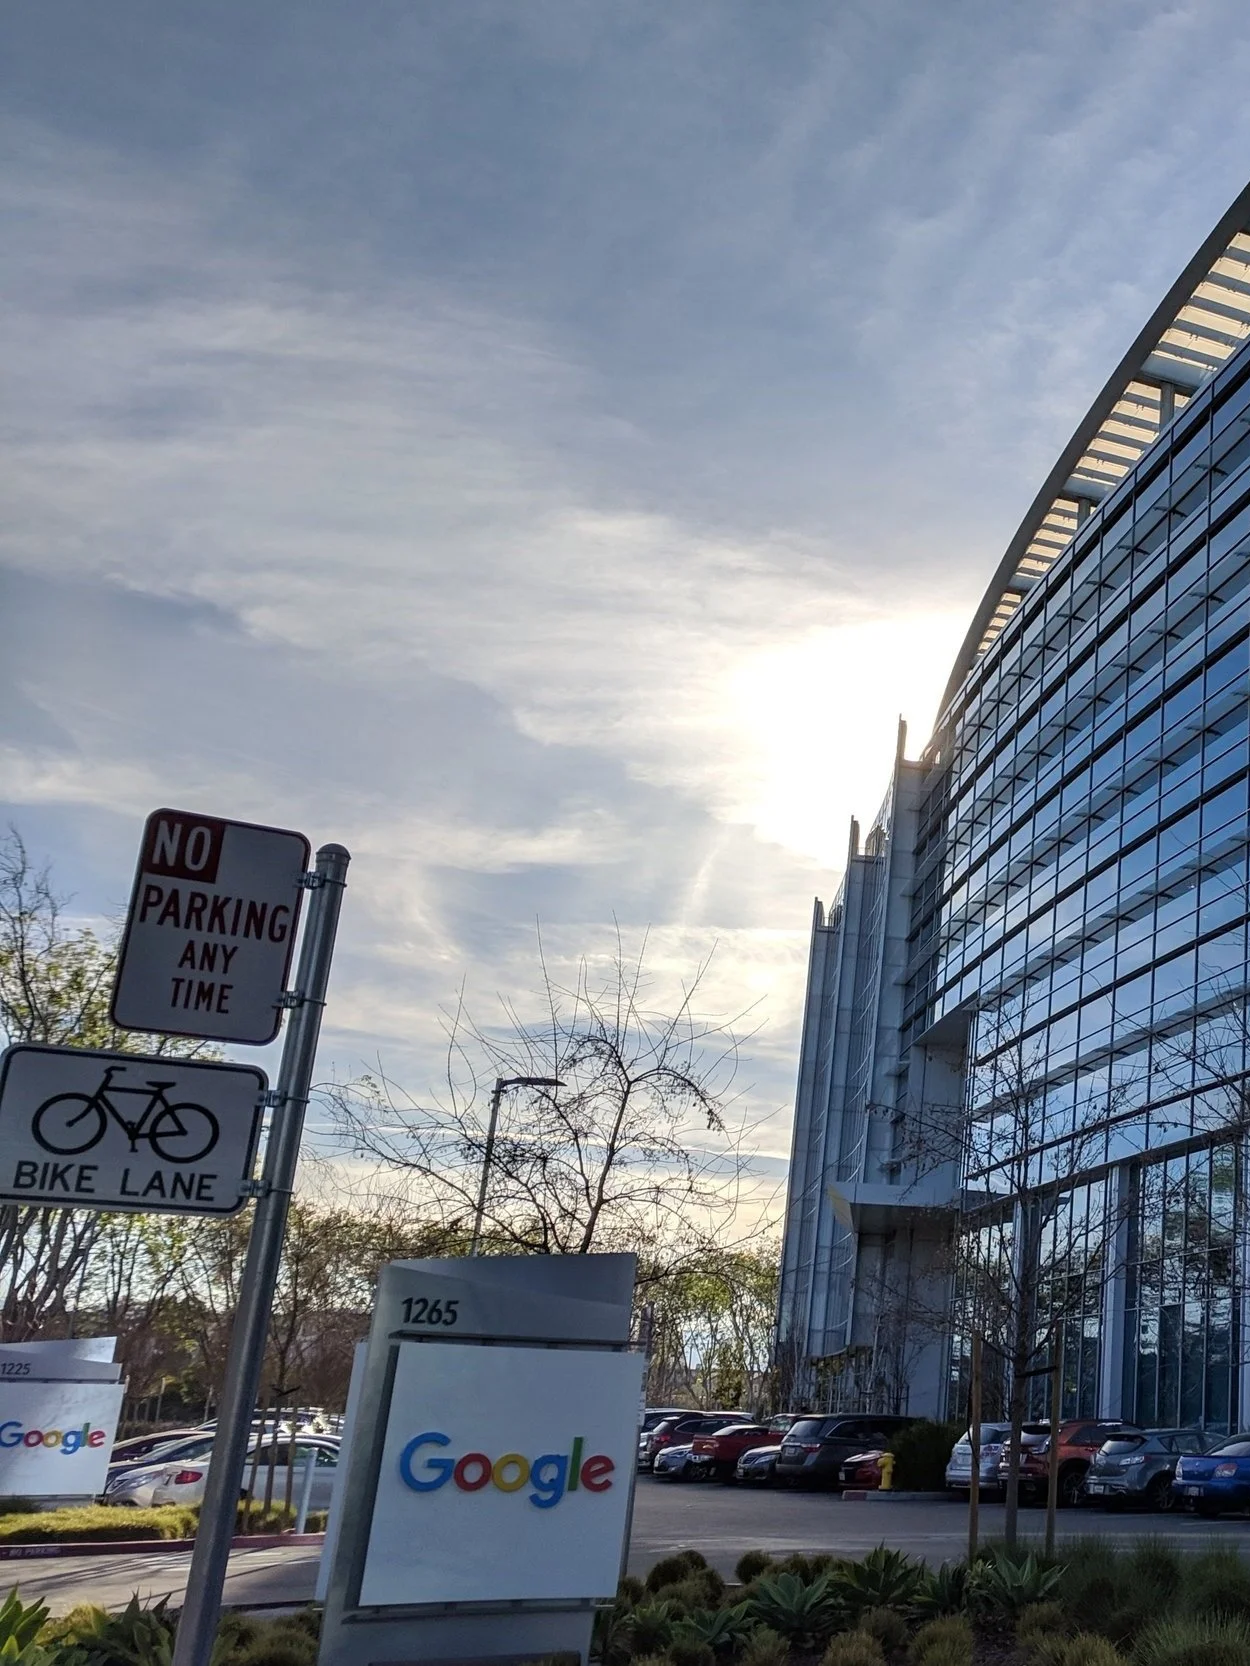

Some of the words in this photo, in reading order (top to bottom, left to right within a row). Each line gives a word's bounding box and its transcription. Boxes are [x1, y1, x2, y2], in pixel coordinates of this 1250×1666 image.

[151, 819, 213, 871] NO
[138, 884, 290, 943] PARKING
[178, 940, 239, 975] ANY
[170, 977, 234, 1014] TIME
[12, 1160, 99, 1193] BIKE
[120, 1168, 218, 1201] LANE
[401, 1297, 459, 1326] 1265
[0, 1362, 31, 1375] 1225
[0, 1421, 105, 1455] Google
[400, 1432, 615, 1509] Google
